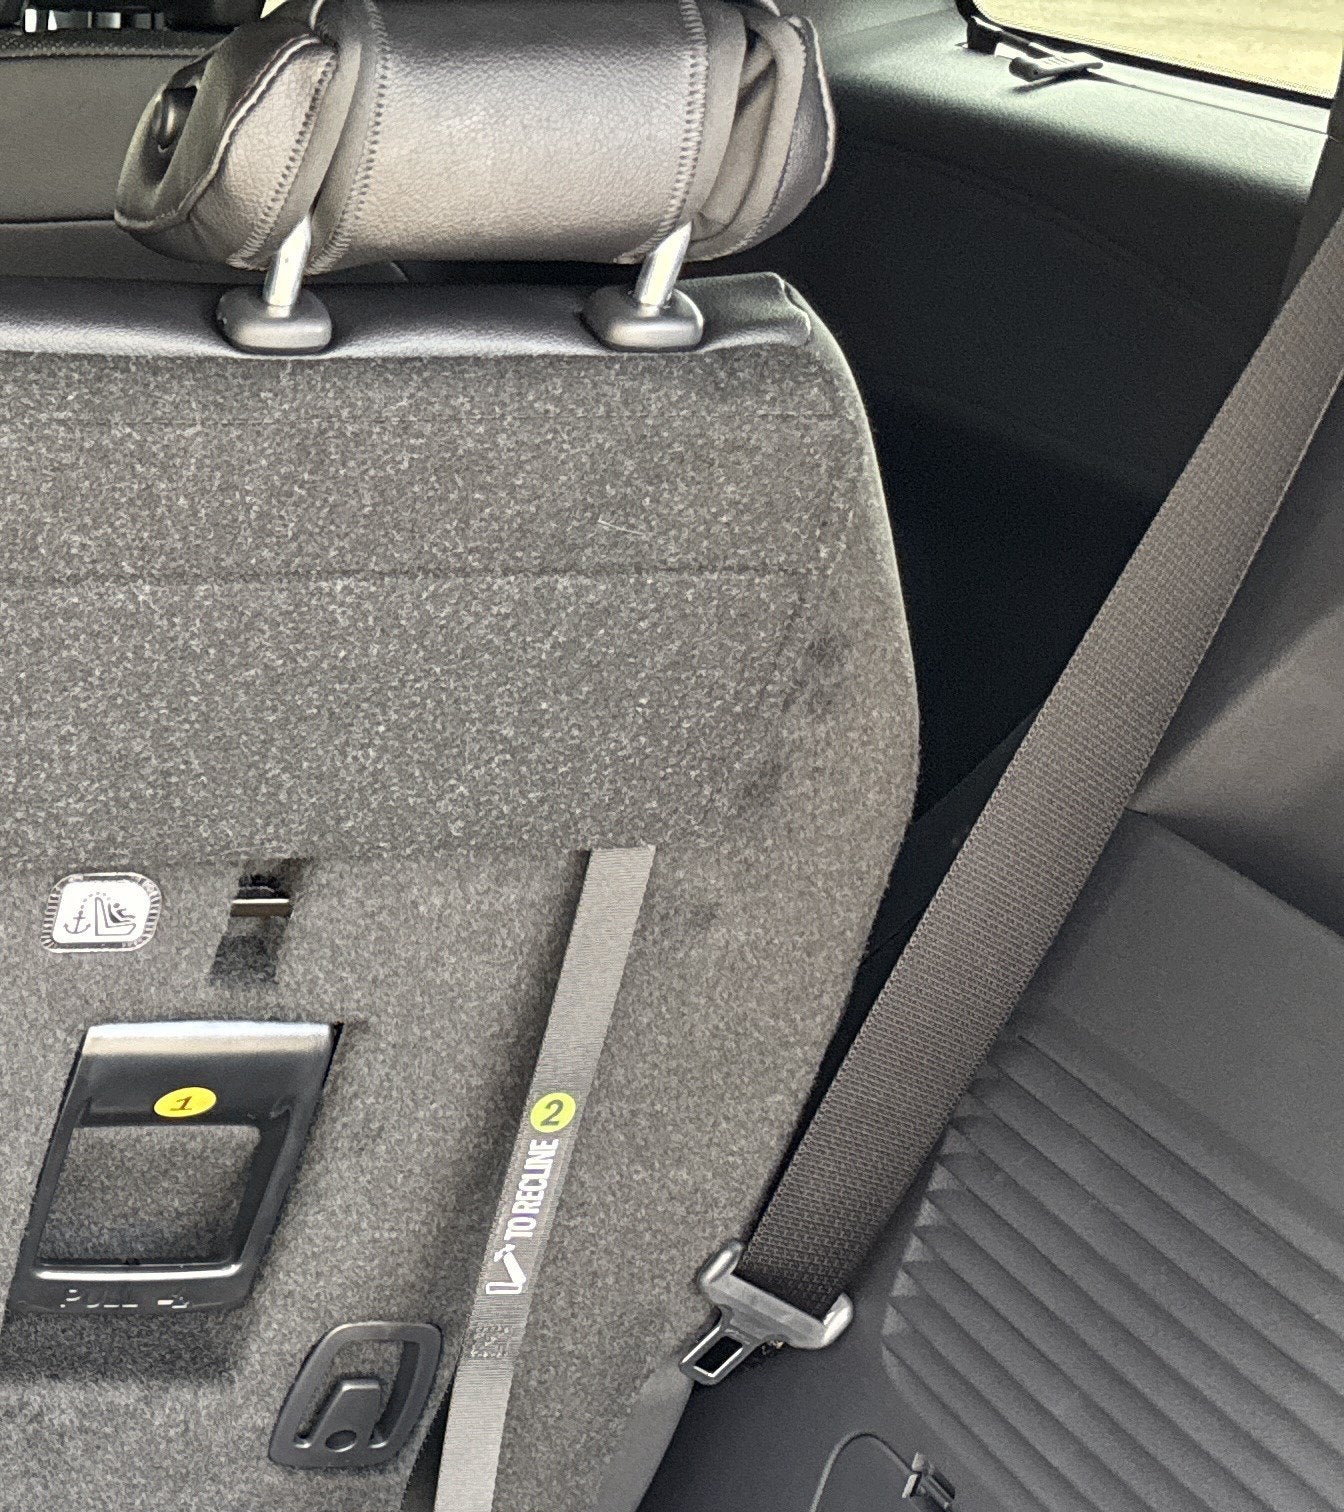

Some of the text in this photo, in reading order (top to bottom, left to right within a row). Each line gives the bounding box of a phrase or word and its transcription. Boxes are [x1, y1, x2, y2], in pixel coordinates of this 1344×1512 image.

[169, 1095, 193, 1112] 1
[540, 1099, 564, 1127] 2
[504, 1139, 560, 1241] TO RECLINE
